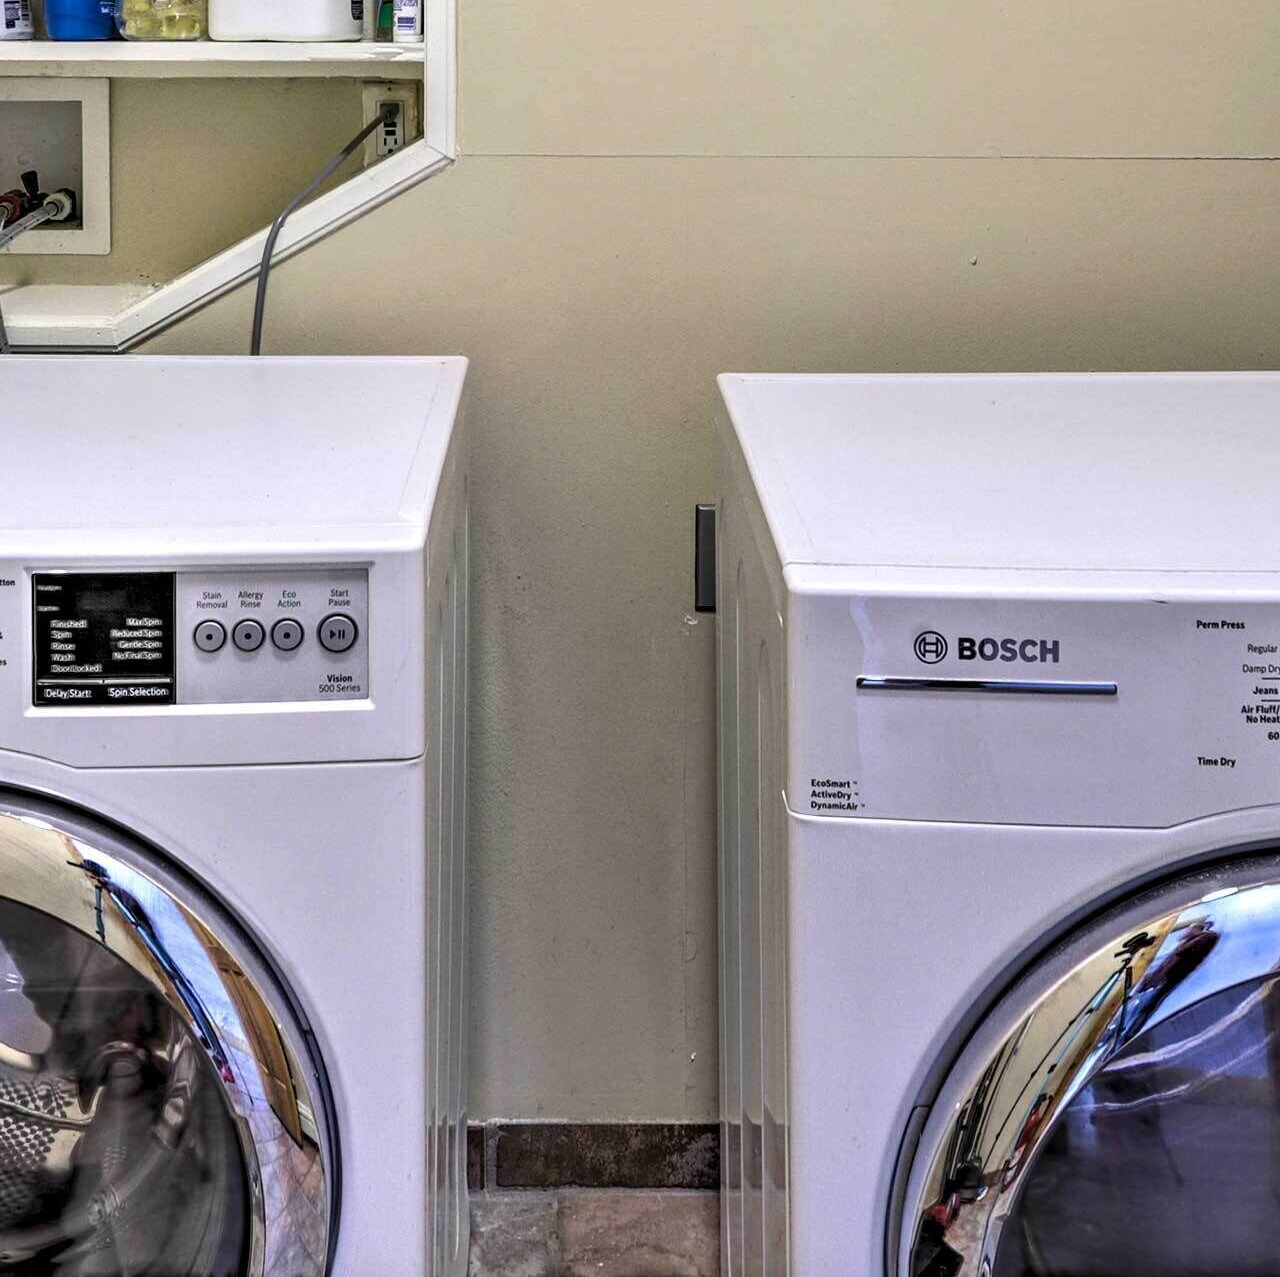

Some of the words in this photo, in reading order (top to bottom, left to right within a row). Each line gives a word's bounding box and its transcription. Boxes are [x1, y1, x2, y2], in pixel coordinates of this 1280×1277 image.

[202, 592, 222, 600] Stain
[238, 591, 264, 600] Allergy
[282, 591, 296, 599] Eco
[330, 589, 348, 598] Start
[196, 601, 228, 609] Removal
[240, 600, 261, 608] Rinse
[277, 599, 301, 608] Action
[328, 599, 351, 607] Pause
[51, 620, 87, 628] Finished
[144, 618, 162, 627] Spin
[1196, 621, 1219, 629] Perm
[1221, 621, 1246, 630] Press
[51, 631, 72, 640] Spin
[111, 629, 144, 638] Reduced
[144, 629, 162, 638] Spin
[51, 642, 76, 650] Rinse
[118, 641, 143, 649] Gentle
[143, 641, 162, 650] Spin
[958, 637, 1060, 663] BOSCH
[1247, 644, 1279, 655] Regular
[126, 652, 142, 660] Final
[143, 652, 162, 661] Spin
[1242, 664, 1266, 674] Damp
[327, 674, 353, 683] Vision
[109, 688, 128, 697] Spin
[129, 687, 167, 696] Selection
[336, 684, 361, 693] Series
[1253, 686, 1279, 695] Jeans
[45, 689, 68, 699] Delay
[69, 690, 91, 698] Start
[1241, 705, 1255, 714] Air
[1256, 705, 1280, 715] Fluff/
[1246, 715, 1259, 724] No
[1260, 715, 1280, 724] Heat
[1268, 732, 1279, 741] 60
[1197, 757, 1218, 766] Time
[1219, 758, 1236, 768] Dry
[811, 779, 851, 789] EcoSmart
[811, 790, 852, 801] ActiveDry
[811, 801, 858, 811] DynamicAir
